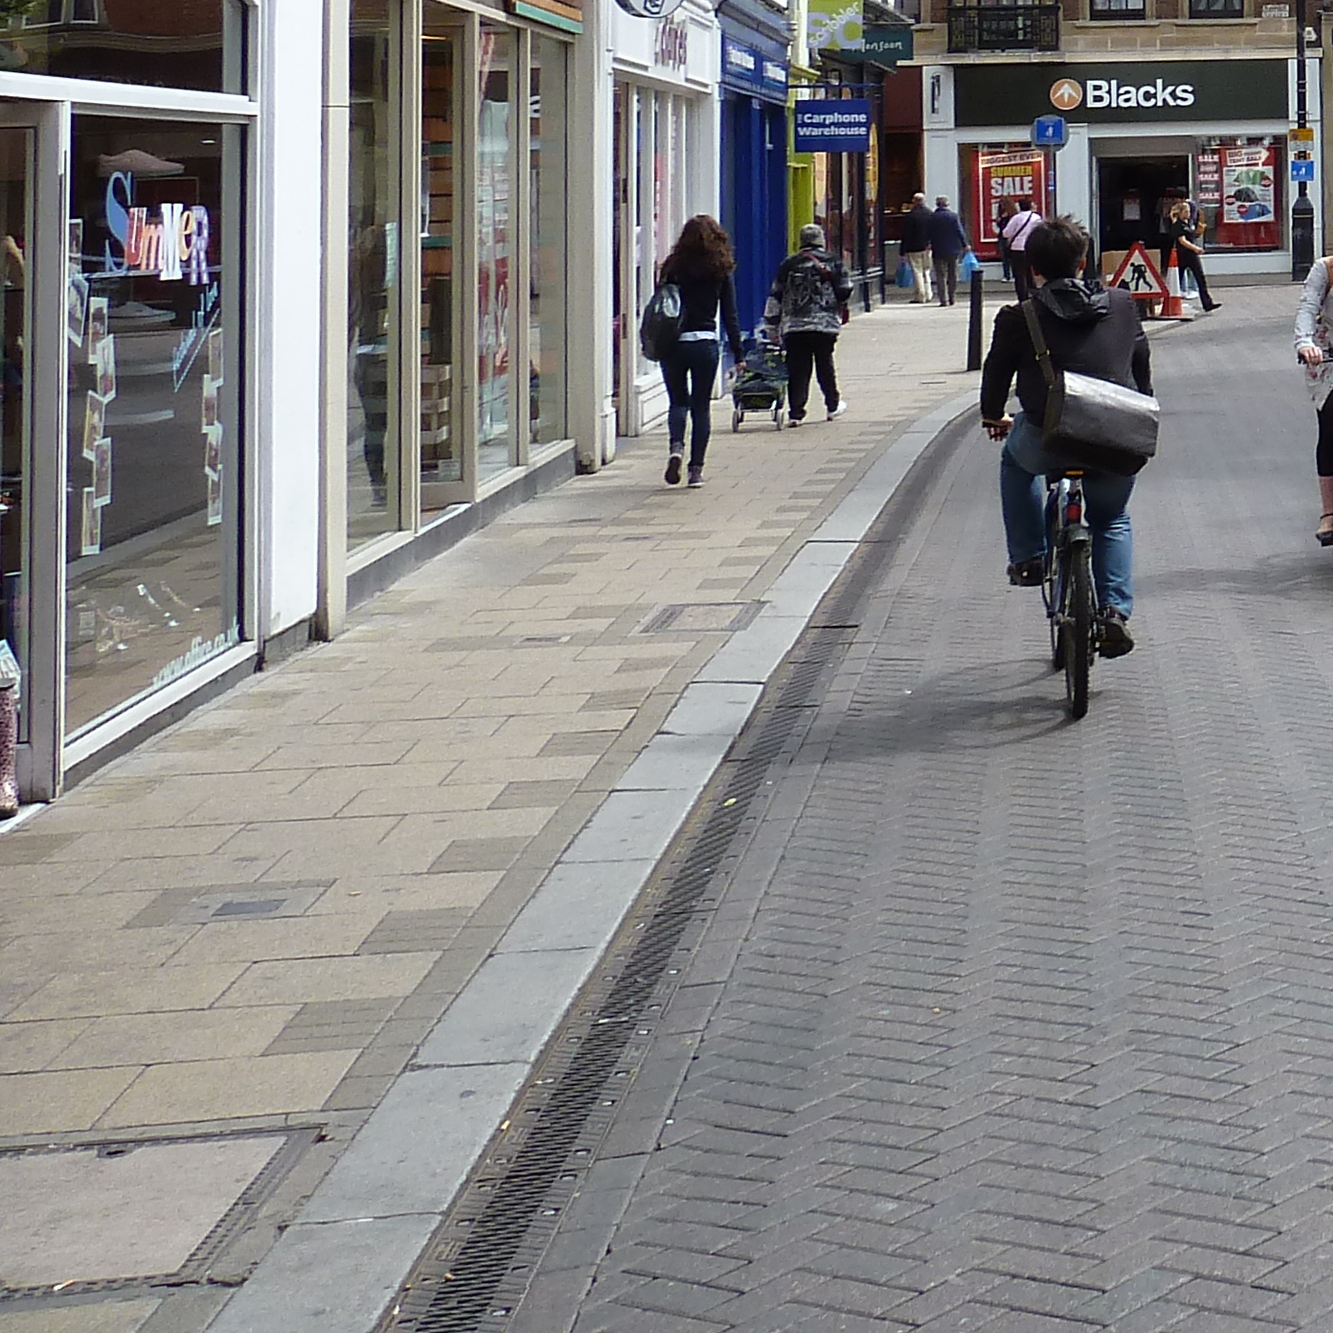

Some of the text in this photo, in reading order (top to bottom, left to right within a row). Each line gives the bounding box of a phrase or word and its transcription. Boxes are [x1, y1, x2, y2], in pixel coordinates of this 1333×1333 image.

[1085, 78, 1195, 109] Blacks
[804, 112, 867, 125] Carphone
[797, 125, 867, 137] Warehouse
[991, 166, 1033, 177] SUMMER
[991, 176, 1033, 196] SALE
